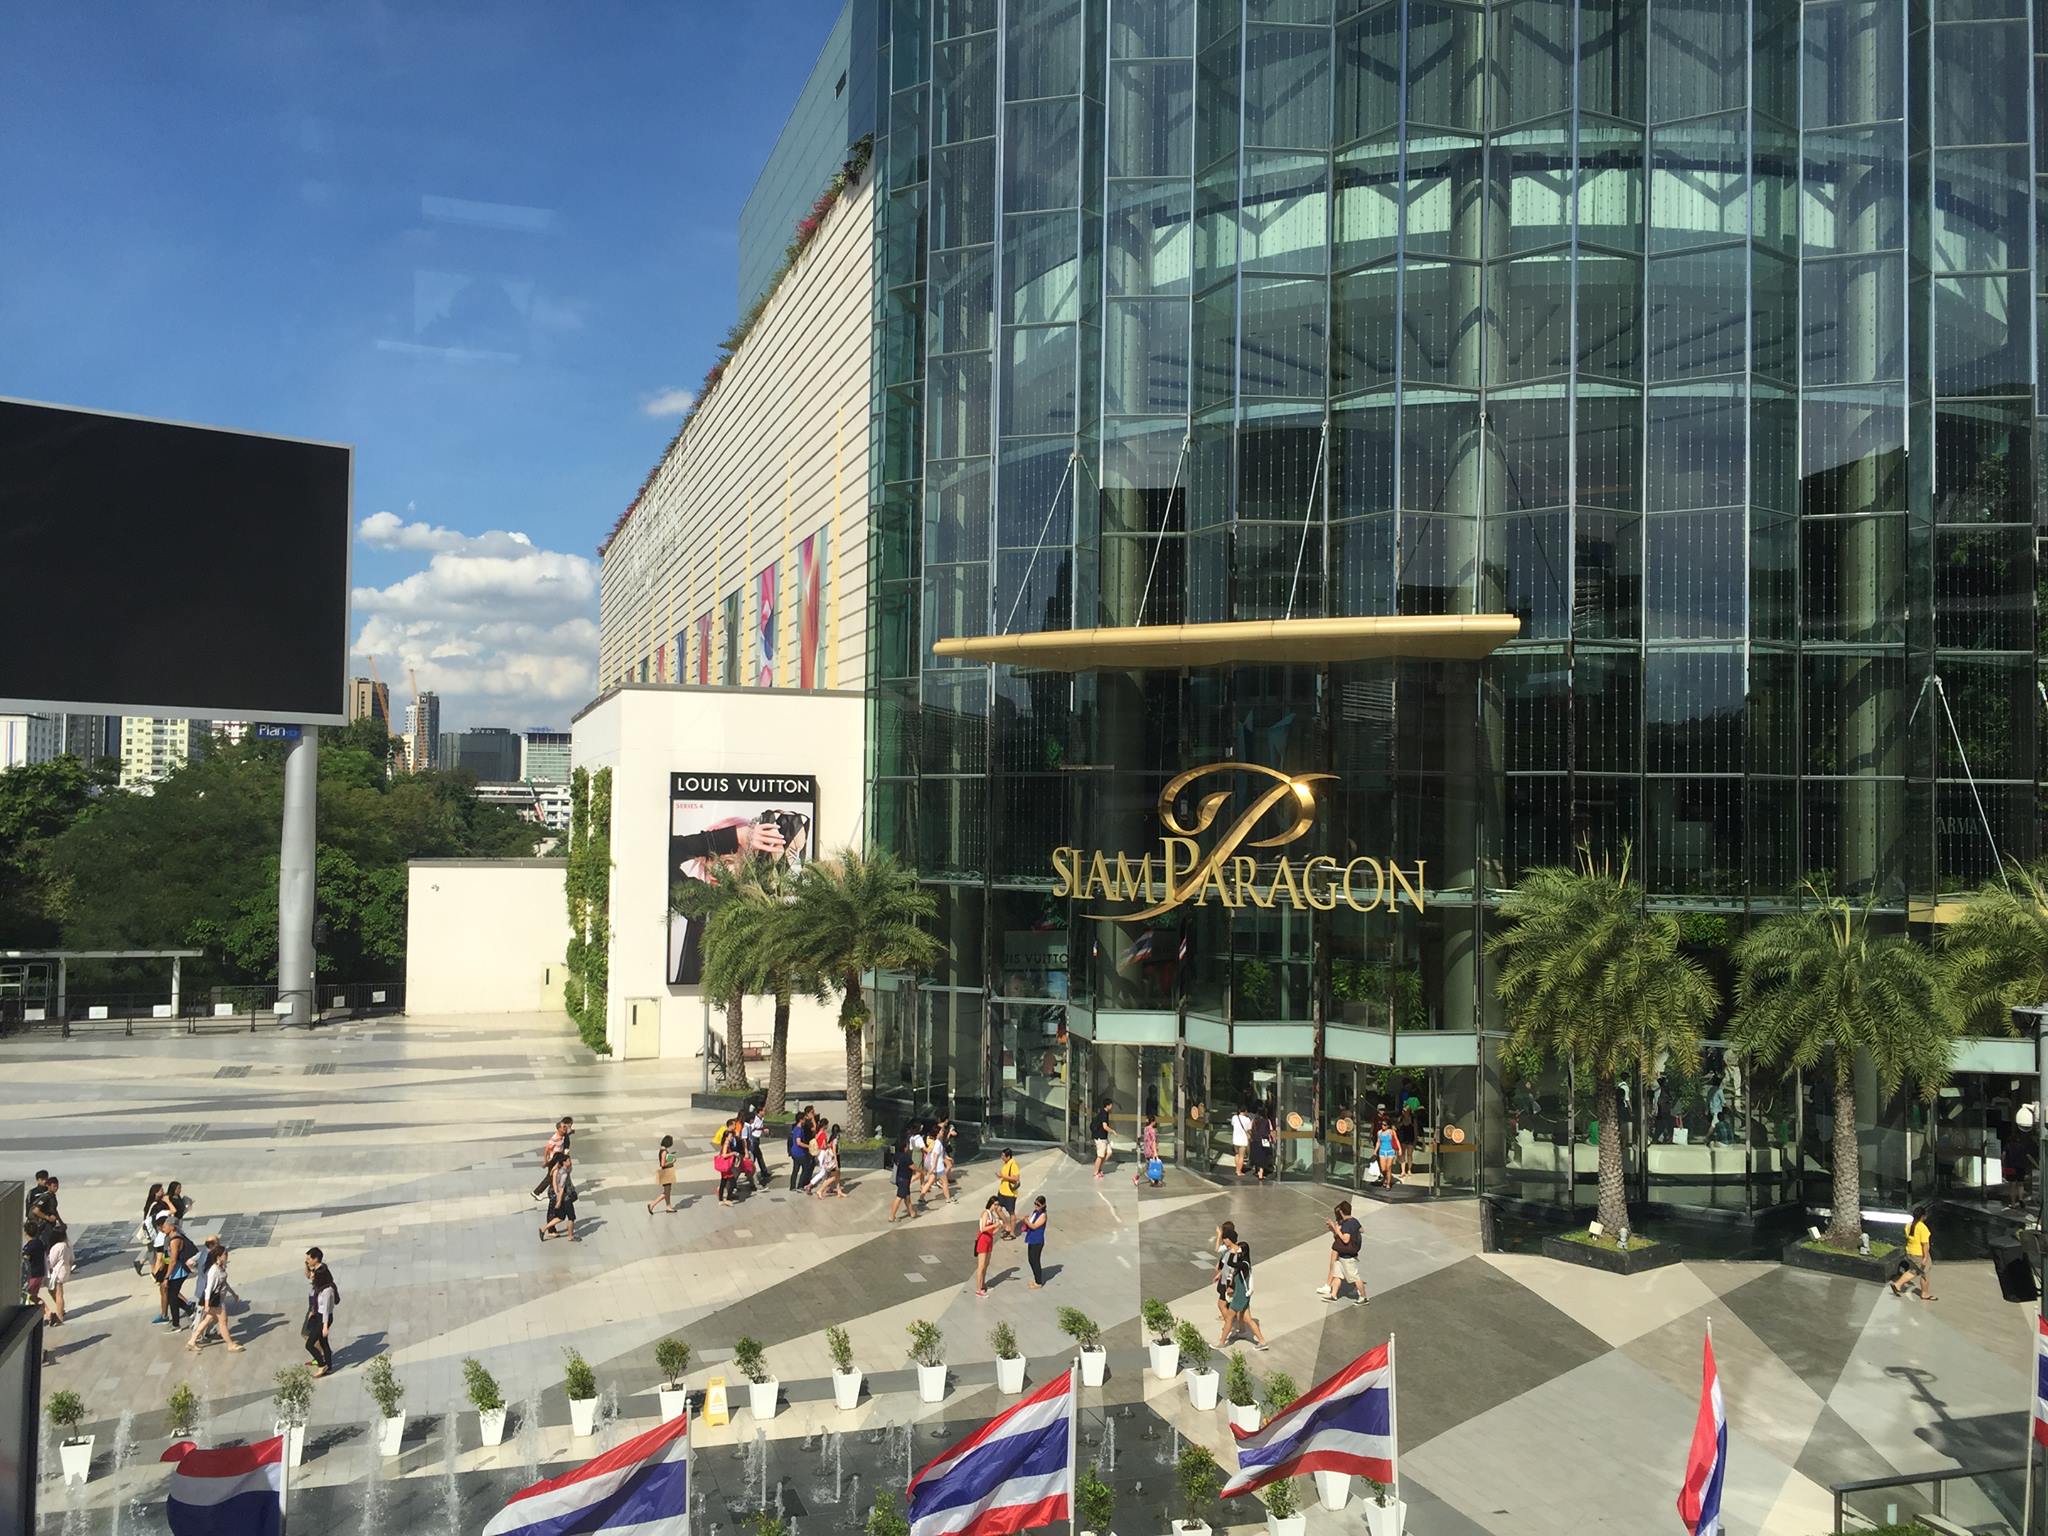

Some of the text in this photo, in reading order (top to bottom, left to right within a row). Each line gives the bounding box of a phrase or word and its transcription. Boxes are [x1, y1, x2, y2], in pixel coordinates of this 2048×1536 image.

[678, 777, 810, 793] LOUIS VUITTON
[1052, 846, 1166, 904] SIAM
